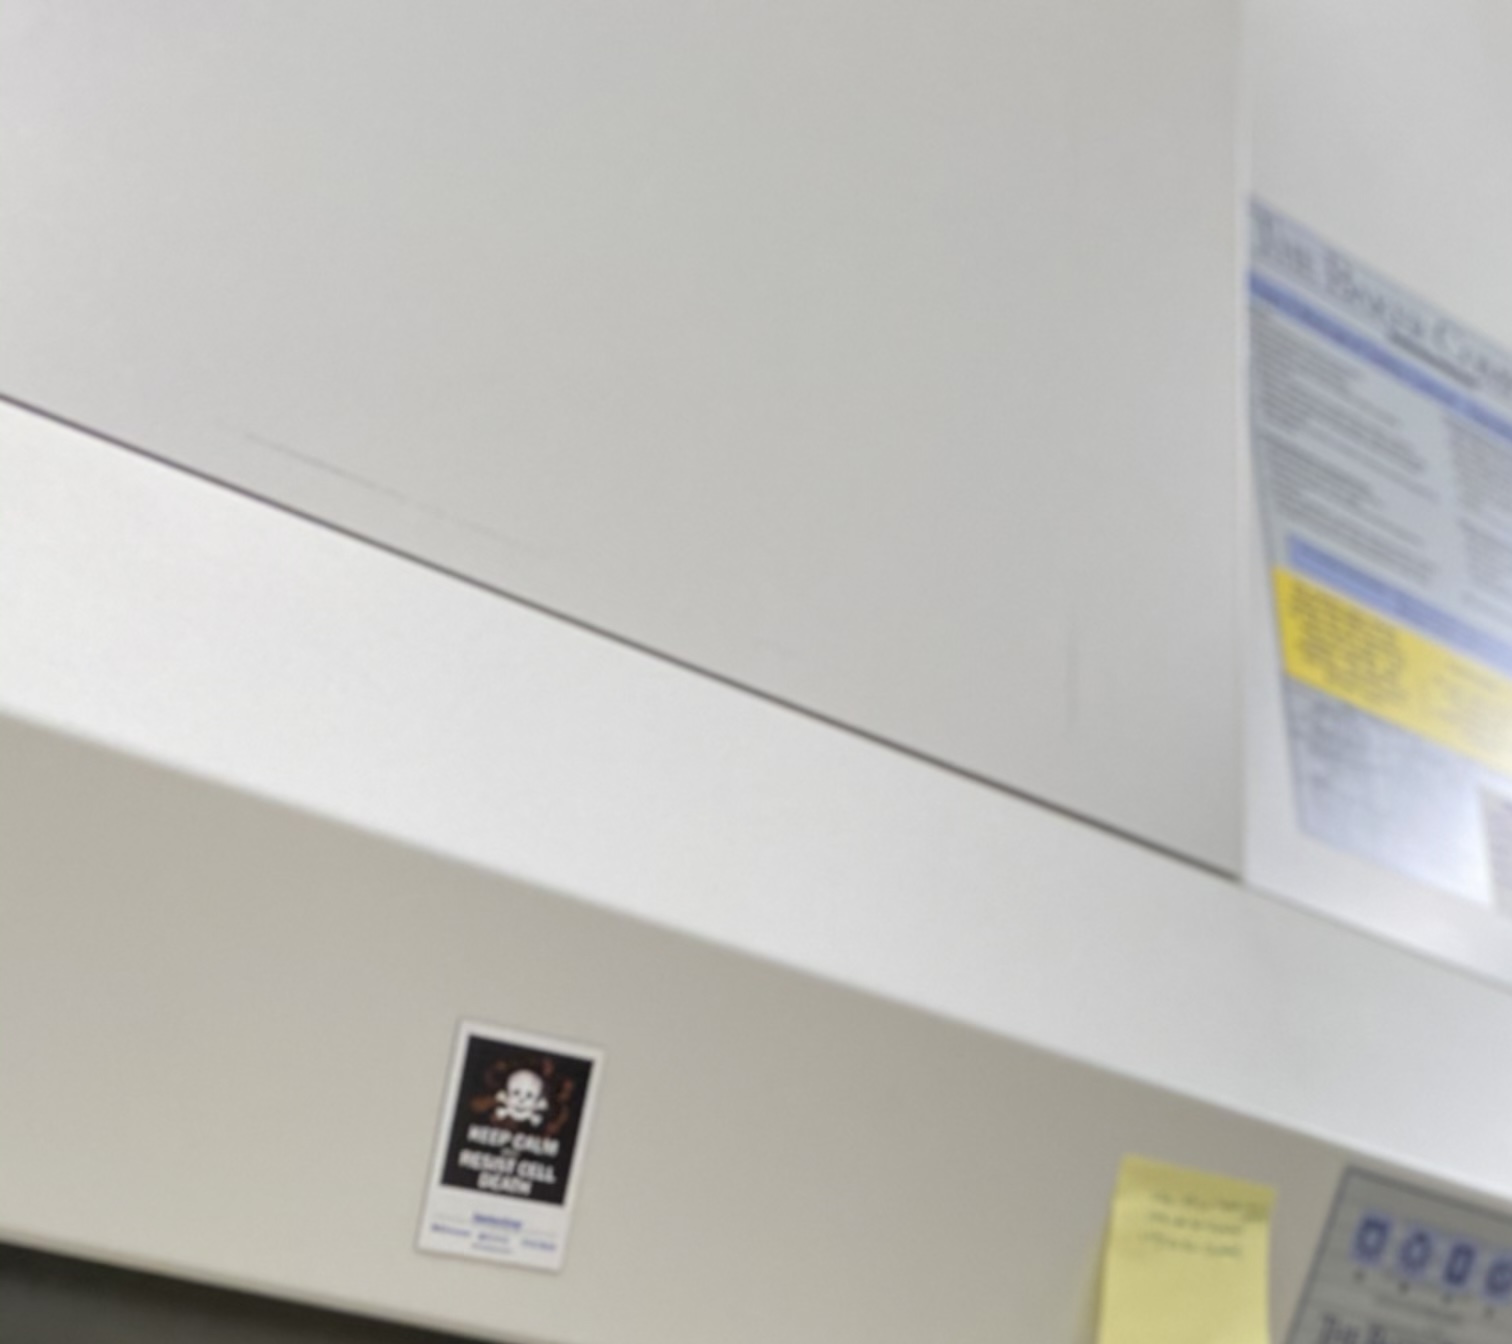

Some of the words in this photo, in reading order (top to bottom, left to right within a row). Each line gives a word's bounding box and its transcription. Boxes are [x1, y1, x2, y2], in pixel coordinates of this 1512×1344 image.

[466, 1122, 512, 1147] KEEP
[512, 1132, 560, 1158] CALM
[458, 1149, 516, 1174] RESIST
[517, 1159, 558, 1184] CELL
[477, 1170, 532, 1196] DEATH
